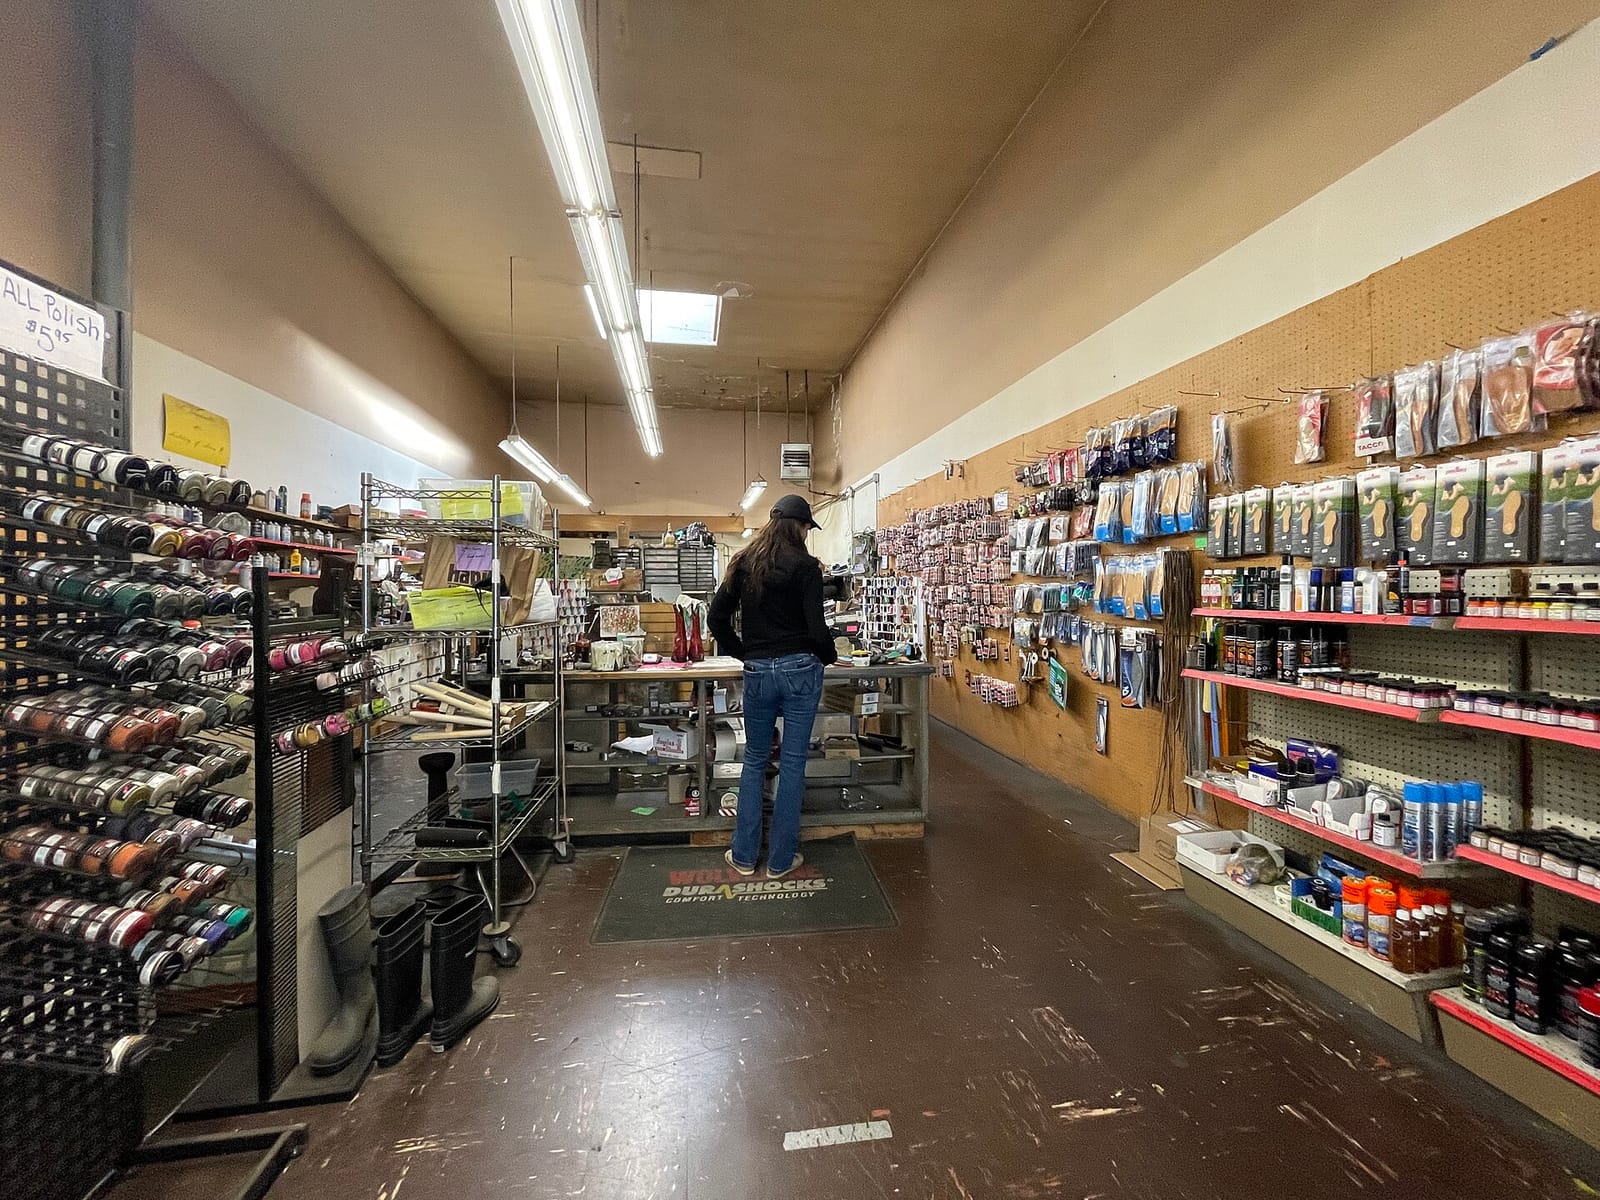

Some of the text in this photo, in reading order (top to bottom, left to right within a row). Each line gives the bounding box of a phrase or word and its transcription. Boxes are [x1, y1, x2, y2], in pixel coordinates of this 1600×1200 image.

[3, 276, 99, 341] ALL Polish
[665, 891, 816, 905] COMFORT TECHNOLOGY
